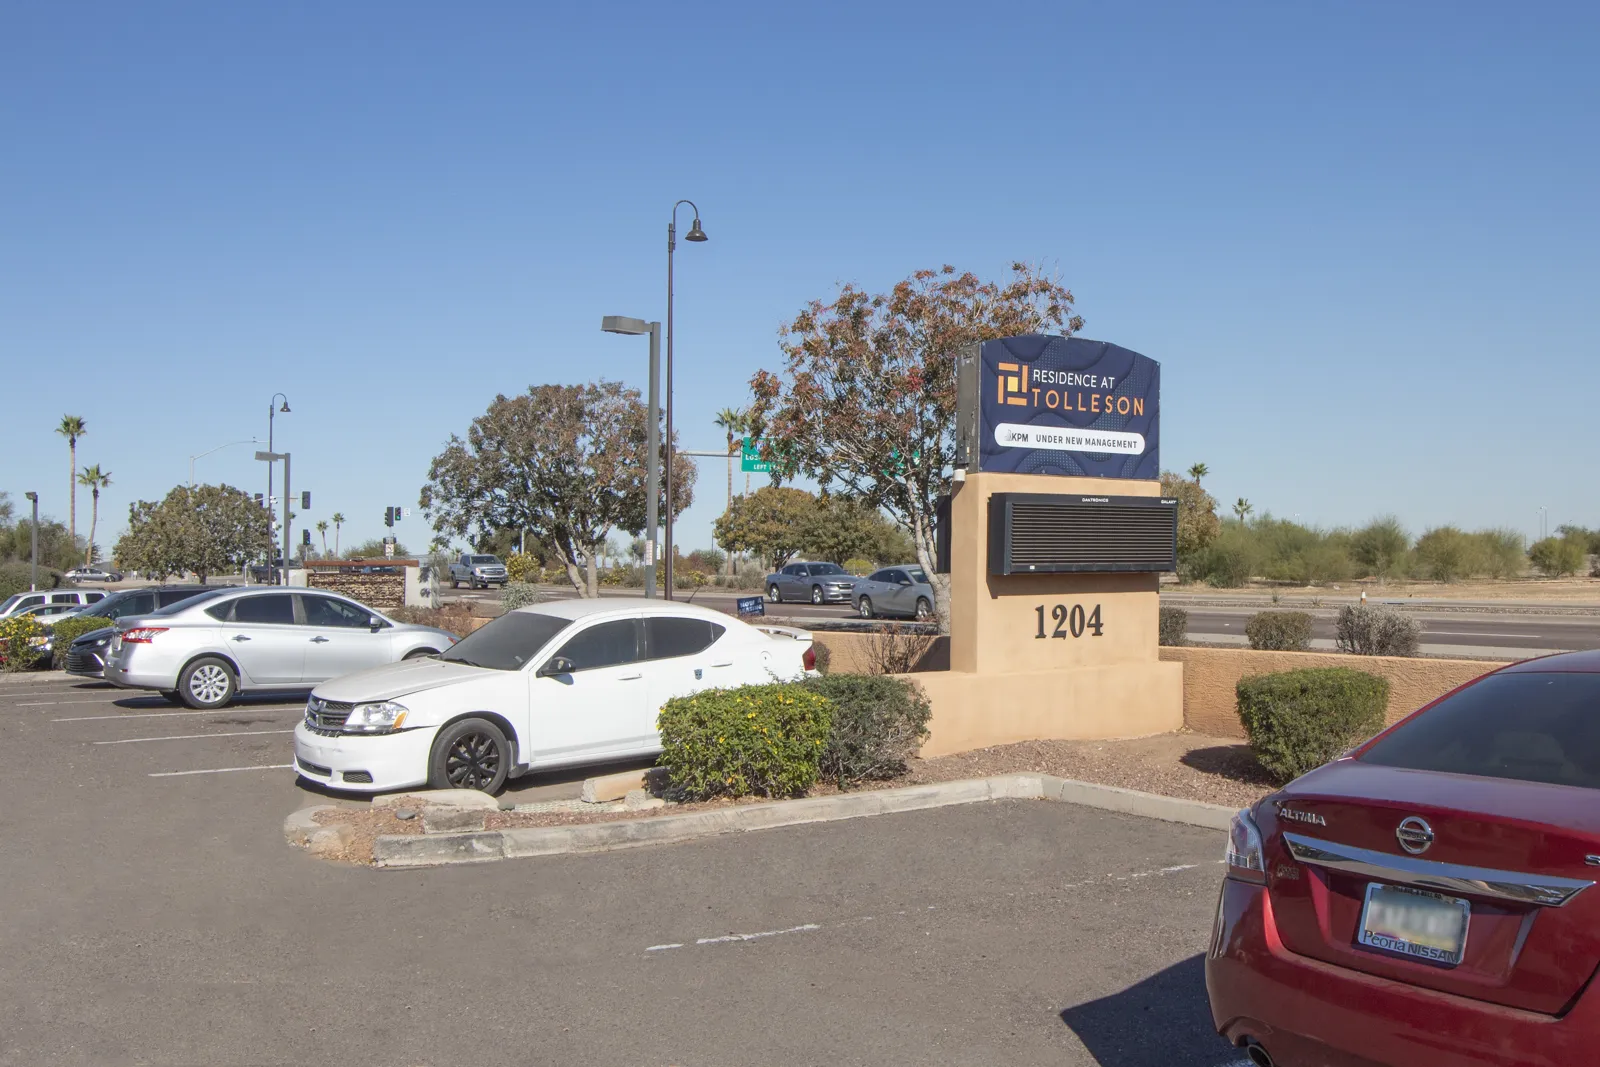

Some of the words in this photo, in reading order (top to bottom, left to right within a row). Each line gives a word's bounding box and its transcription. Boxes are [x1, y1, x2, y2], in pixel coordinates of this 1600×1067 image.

[1033, 369, 1097, 388] RESIDENCE
[1100, 376, 1115, 389] AT
[1032, 388, 1144, 416] TOLLESON
[1011, 433, 1029, 442] KPM
[1036, 434, 1063, 444] UNDER
[1066, 436, 1083, 445] NEW
[1085, 438, 1138, 448] MANAGEMENT
[1034, 603, 1104, 640] 1204
[1280, 807, 1327, 827] ALTIMA
[1363, 929, 1405, 951] Peoria
[1407, 943, 1457, 963] NISSAN
